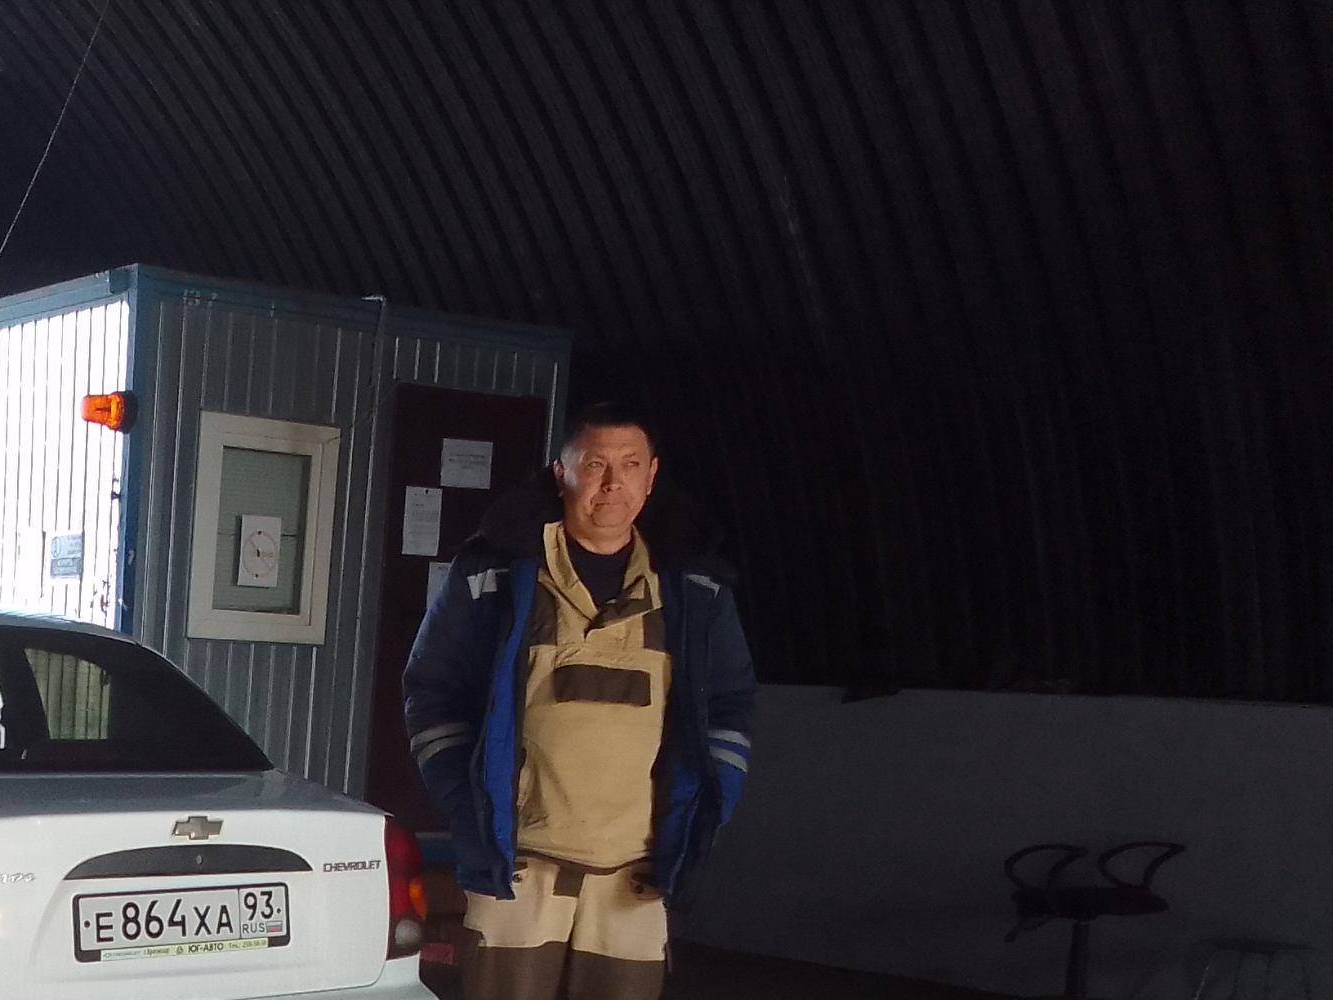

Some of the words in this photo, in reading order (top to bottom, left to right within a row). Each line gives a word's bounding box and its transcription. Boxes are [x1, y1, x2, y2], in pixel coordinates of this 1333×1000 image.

[323, 860, 382, 873] CHEVROLET
[243, 890, 274, 921] 93
[242, 922, 266, 934] RUS
